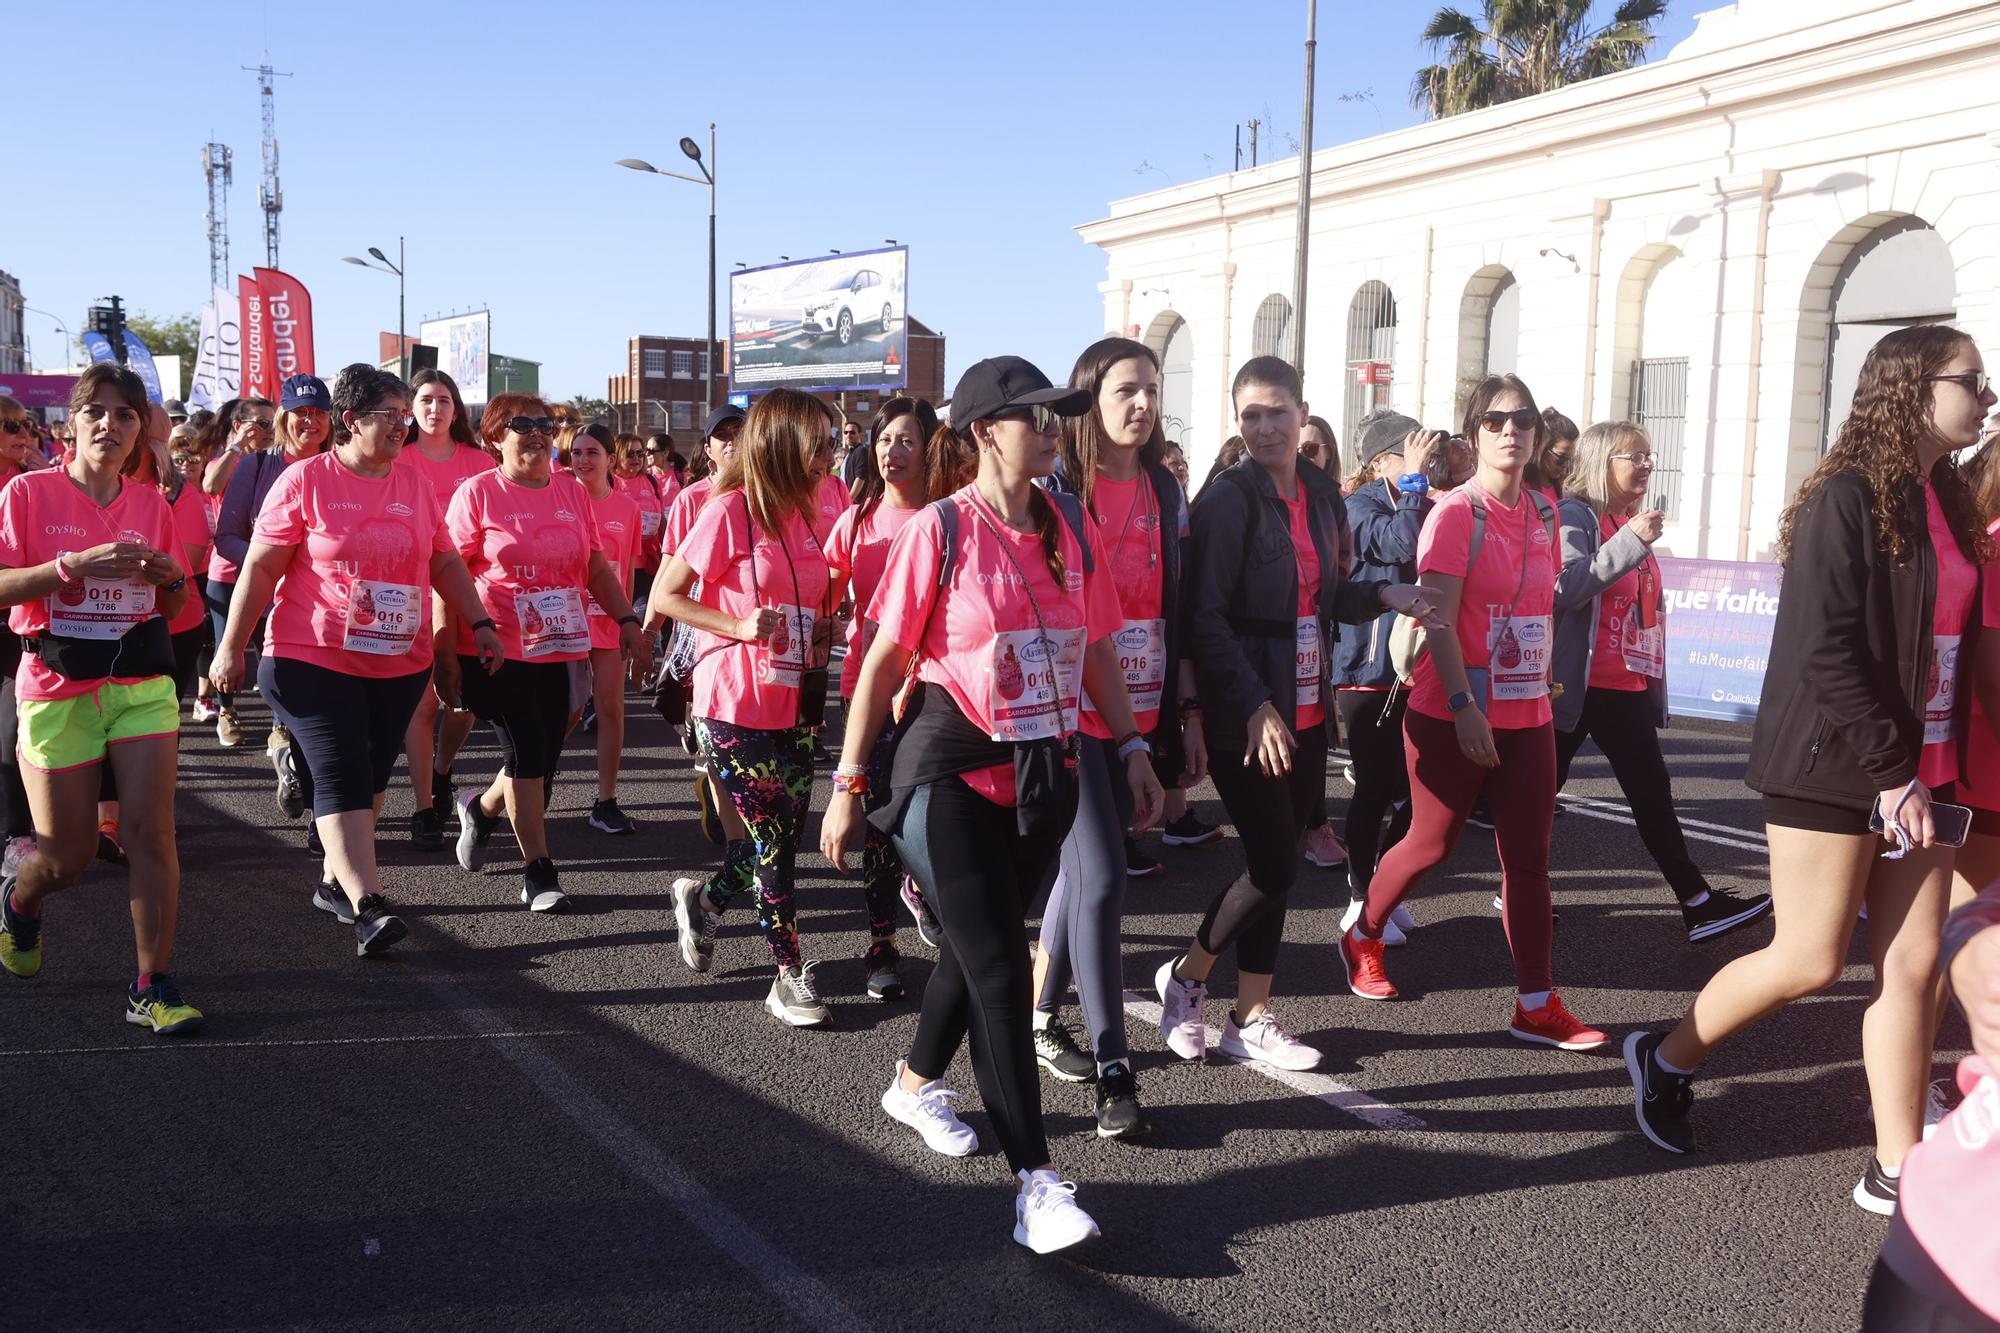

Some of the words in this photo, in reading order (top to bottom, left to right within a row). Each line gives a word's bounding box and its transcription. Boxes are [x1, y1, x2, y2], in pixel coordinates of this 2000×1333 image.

[327, 502, 362, 511] OYSHO
[45, 525, 87, 537] OYSHO
[333, 560, 359, 577] TU
[513, 564, 537, 580] TU
[976, 573, 1022, 586] OYSHO
[88, 588, 123, 601] 016
[95, 603, 117, 611] 1786
[63, 613, 93, 621] CARRERA
[377, 611, 404, 624] 016
[544, 614, 567, 626] 016
[60, 624, 93, 633] OYSHO
[381, 623, 399, 632] 6211
[352, 640, 378, 649] OYSHO
[1296, 650, 1318, 664] 016
[1523, 648, 1544, 661] 016
[1120, 656, 1146, 670] 016
[1027, 671, 1053, 688] 016
[1126, 672, 1140, 681] 495
[1500, 686, 1529, 694] OYSHO
[1004, 722, 1038, 733] OYSHO
